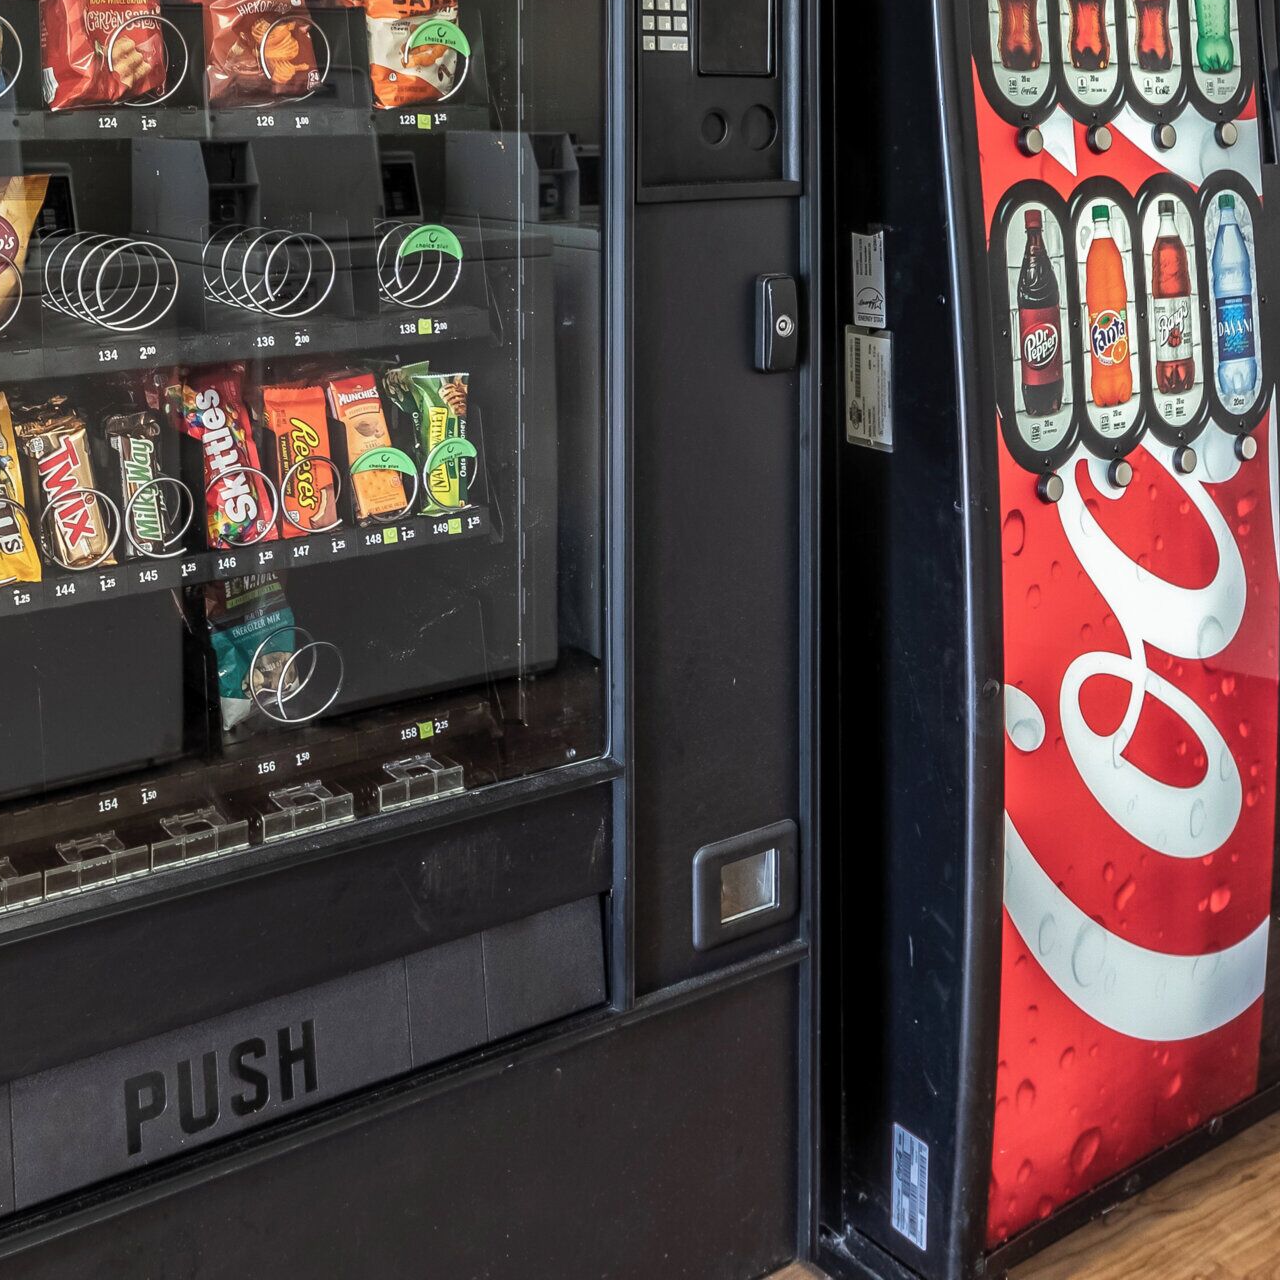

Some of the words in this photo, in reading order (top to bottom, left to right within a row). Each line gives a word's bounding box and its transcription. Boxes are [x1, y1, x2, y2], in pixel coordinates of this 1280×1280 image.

[98, 118, 117, 128] 124
[256, 116, 274, 126] 126
[400, 115, 416, 124] 128
[399, 323, 416, 334] 138
[256, 336, 274, 348] 136
[1035, 331, 1050, 345] Dr
[1091, 320, 1126, 354] Fanta
[1025, 333, 1057, 360] Pepper
[98, 349, 118, 362] 134
[339, 388, 379, 406] MUNCHIES
[195, 388, 258, 525] Skittles
[290, 417, 318, 510] Reese's
[433, 524, 448, 534] 149
[365, 534, 382, 545] 148
[293, 546, 310, 558] 147
[218, 557, 236, 569] 146
[139, 571, 158, 582] 145
[56, 584, 76, 596] 144
[232, 621, 265, 638] ENERGIZER
[267, 612, 281, 625] MIX
[401, 727, 417, 740] 158
[258, 760, 276, 774] 156
[98, 798, 118, 811] 154
[124, 1019, 318, 1157] PUSH
